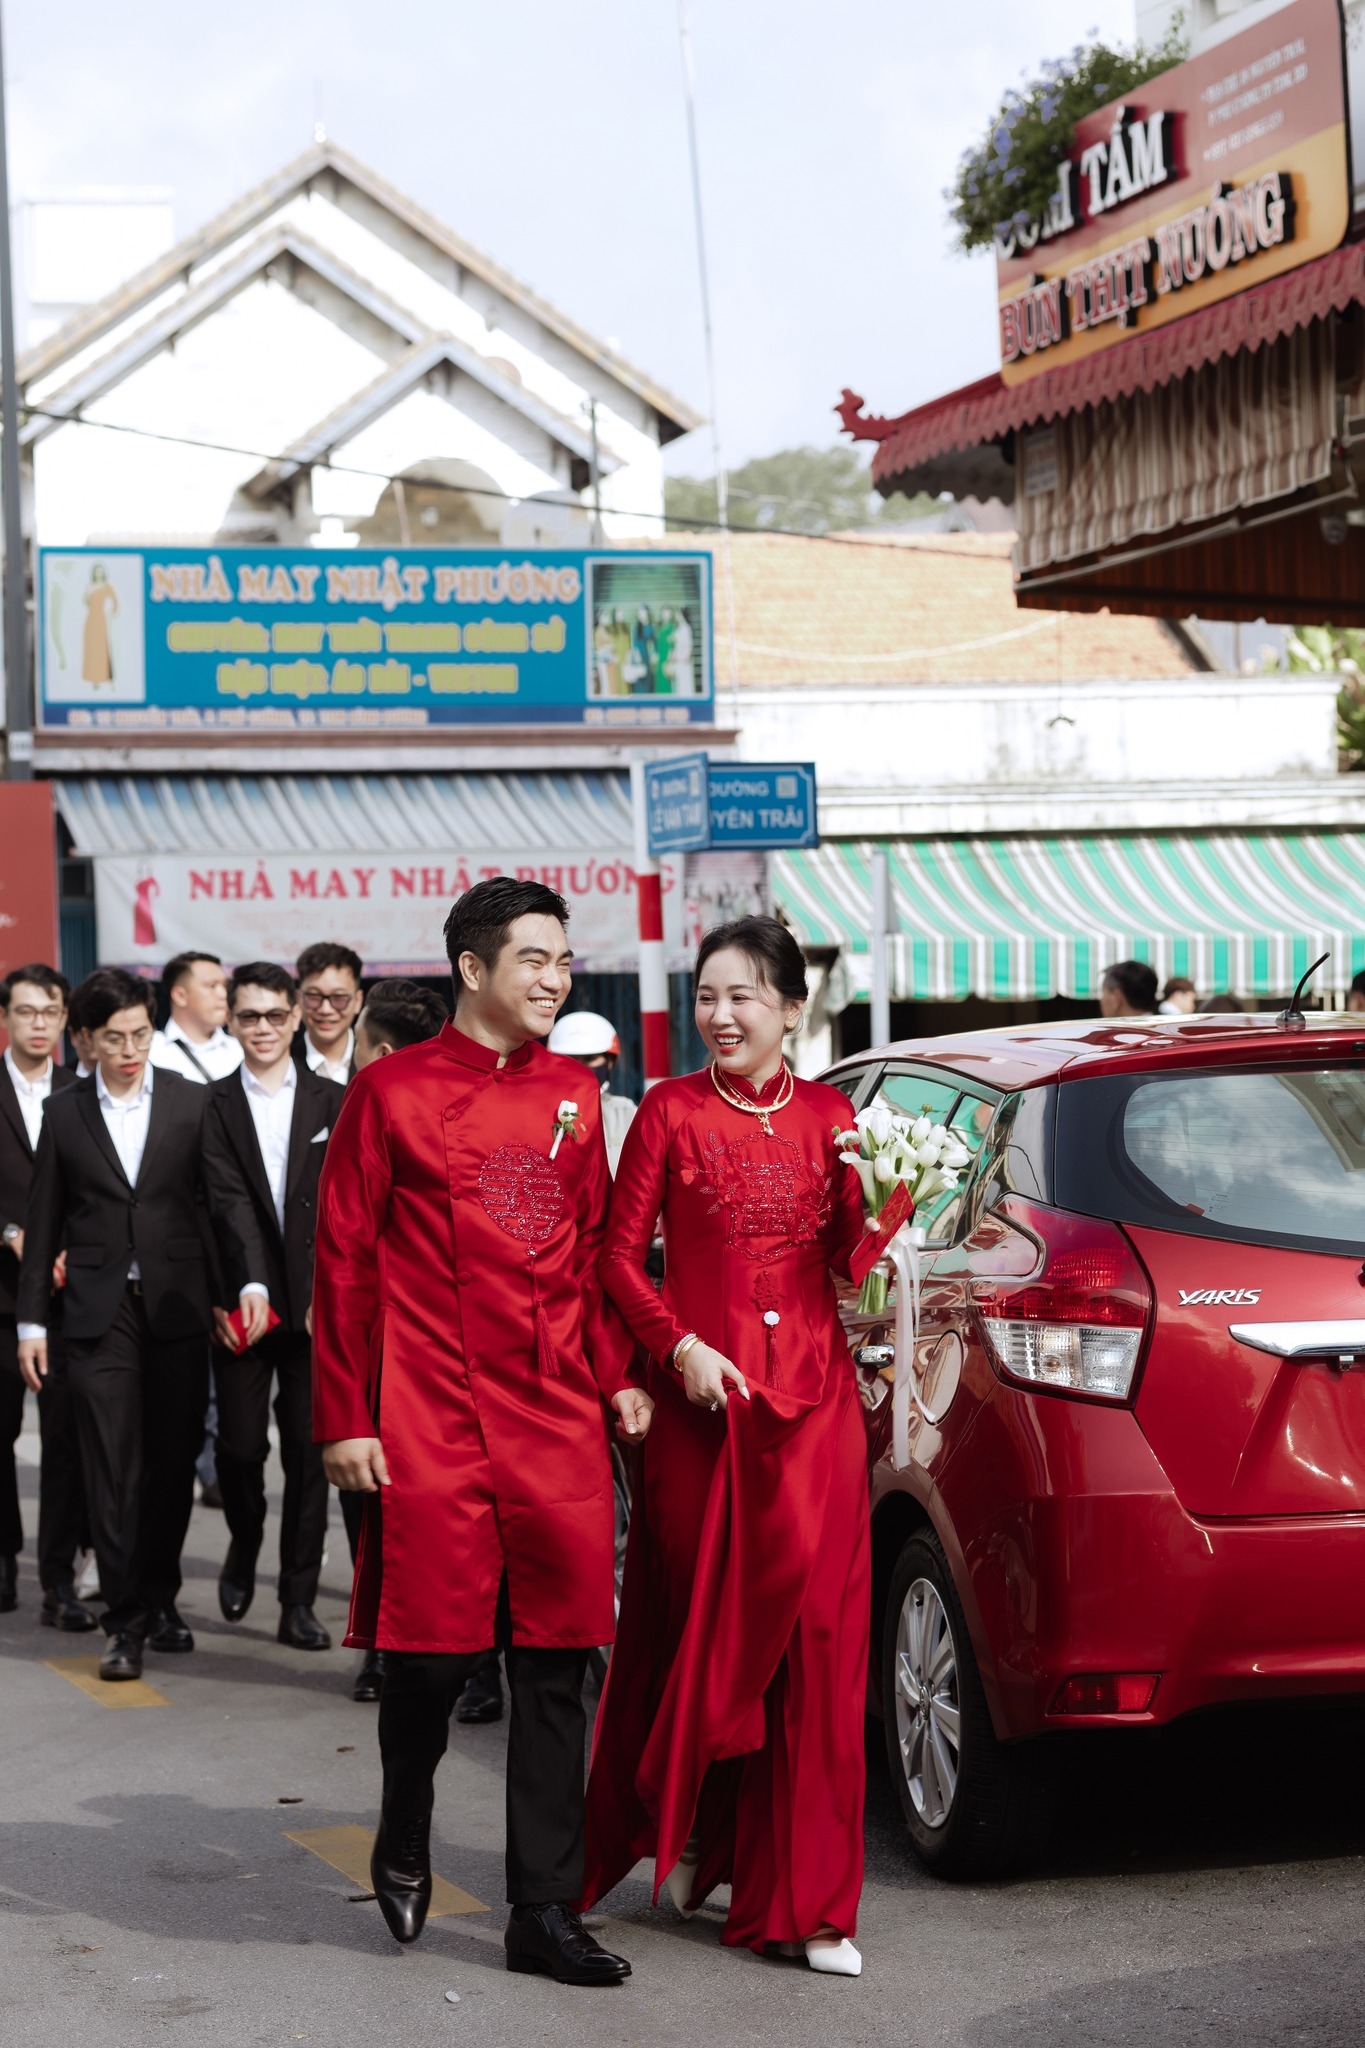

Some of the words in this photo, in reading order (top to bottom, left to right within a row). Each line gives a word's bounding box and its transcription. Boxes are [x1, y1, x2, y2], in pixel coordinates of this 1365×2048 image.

[1081, 104, 1168, 216] TẤM
[1000, 272, 1062, 362] BÚN
[1065, 236, 1152, 329] THỊT
[149, 555, 233, 602] NHÀ
[238, 565, 320, 602] MAY
[325, 556, 428, 612] NHẬT
[432, 560, 582, 603] PHƯƠNG
[289, 866, 375, 898] MAY
